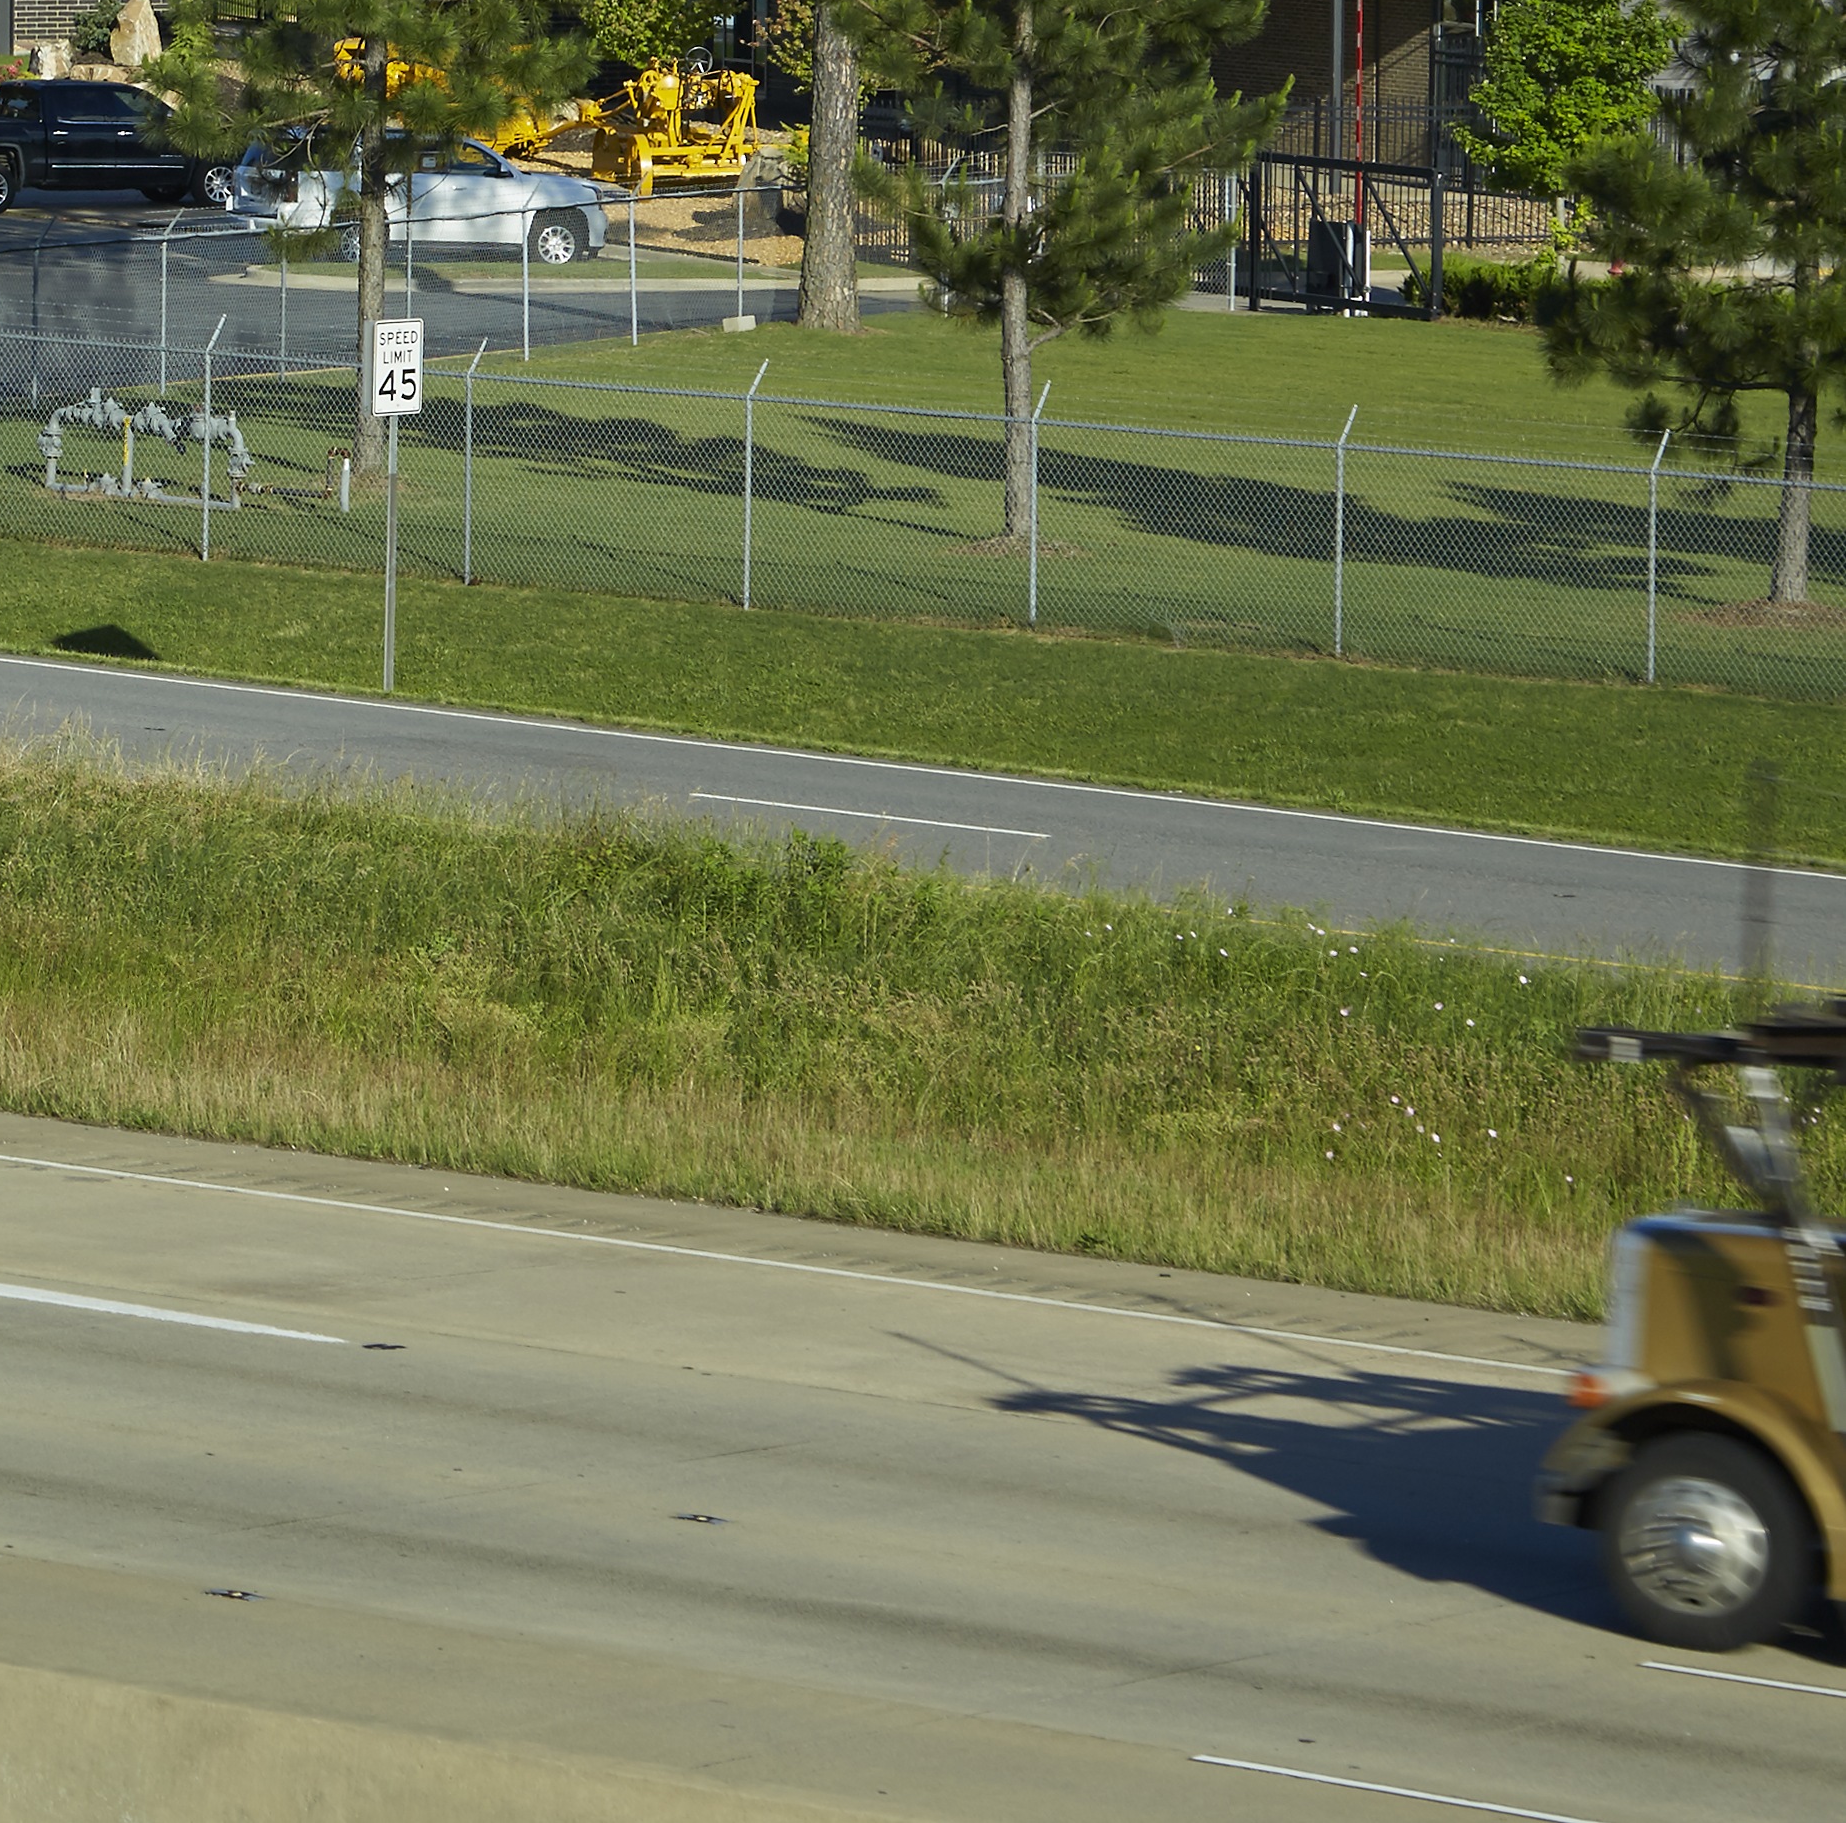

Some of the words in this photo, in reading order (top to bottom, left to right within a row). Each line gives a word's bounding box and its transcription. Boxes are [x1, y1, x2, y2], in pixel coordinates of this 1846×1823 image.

[380, 331, 418, 346] SPEED
[383, 350, 412, 364] LIMIT
[378, 368, 417, 401] 45
